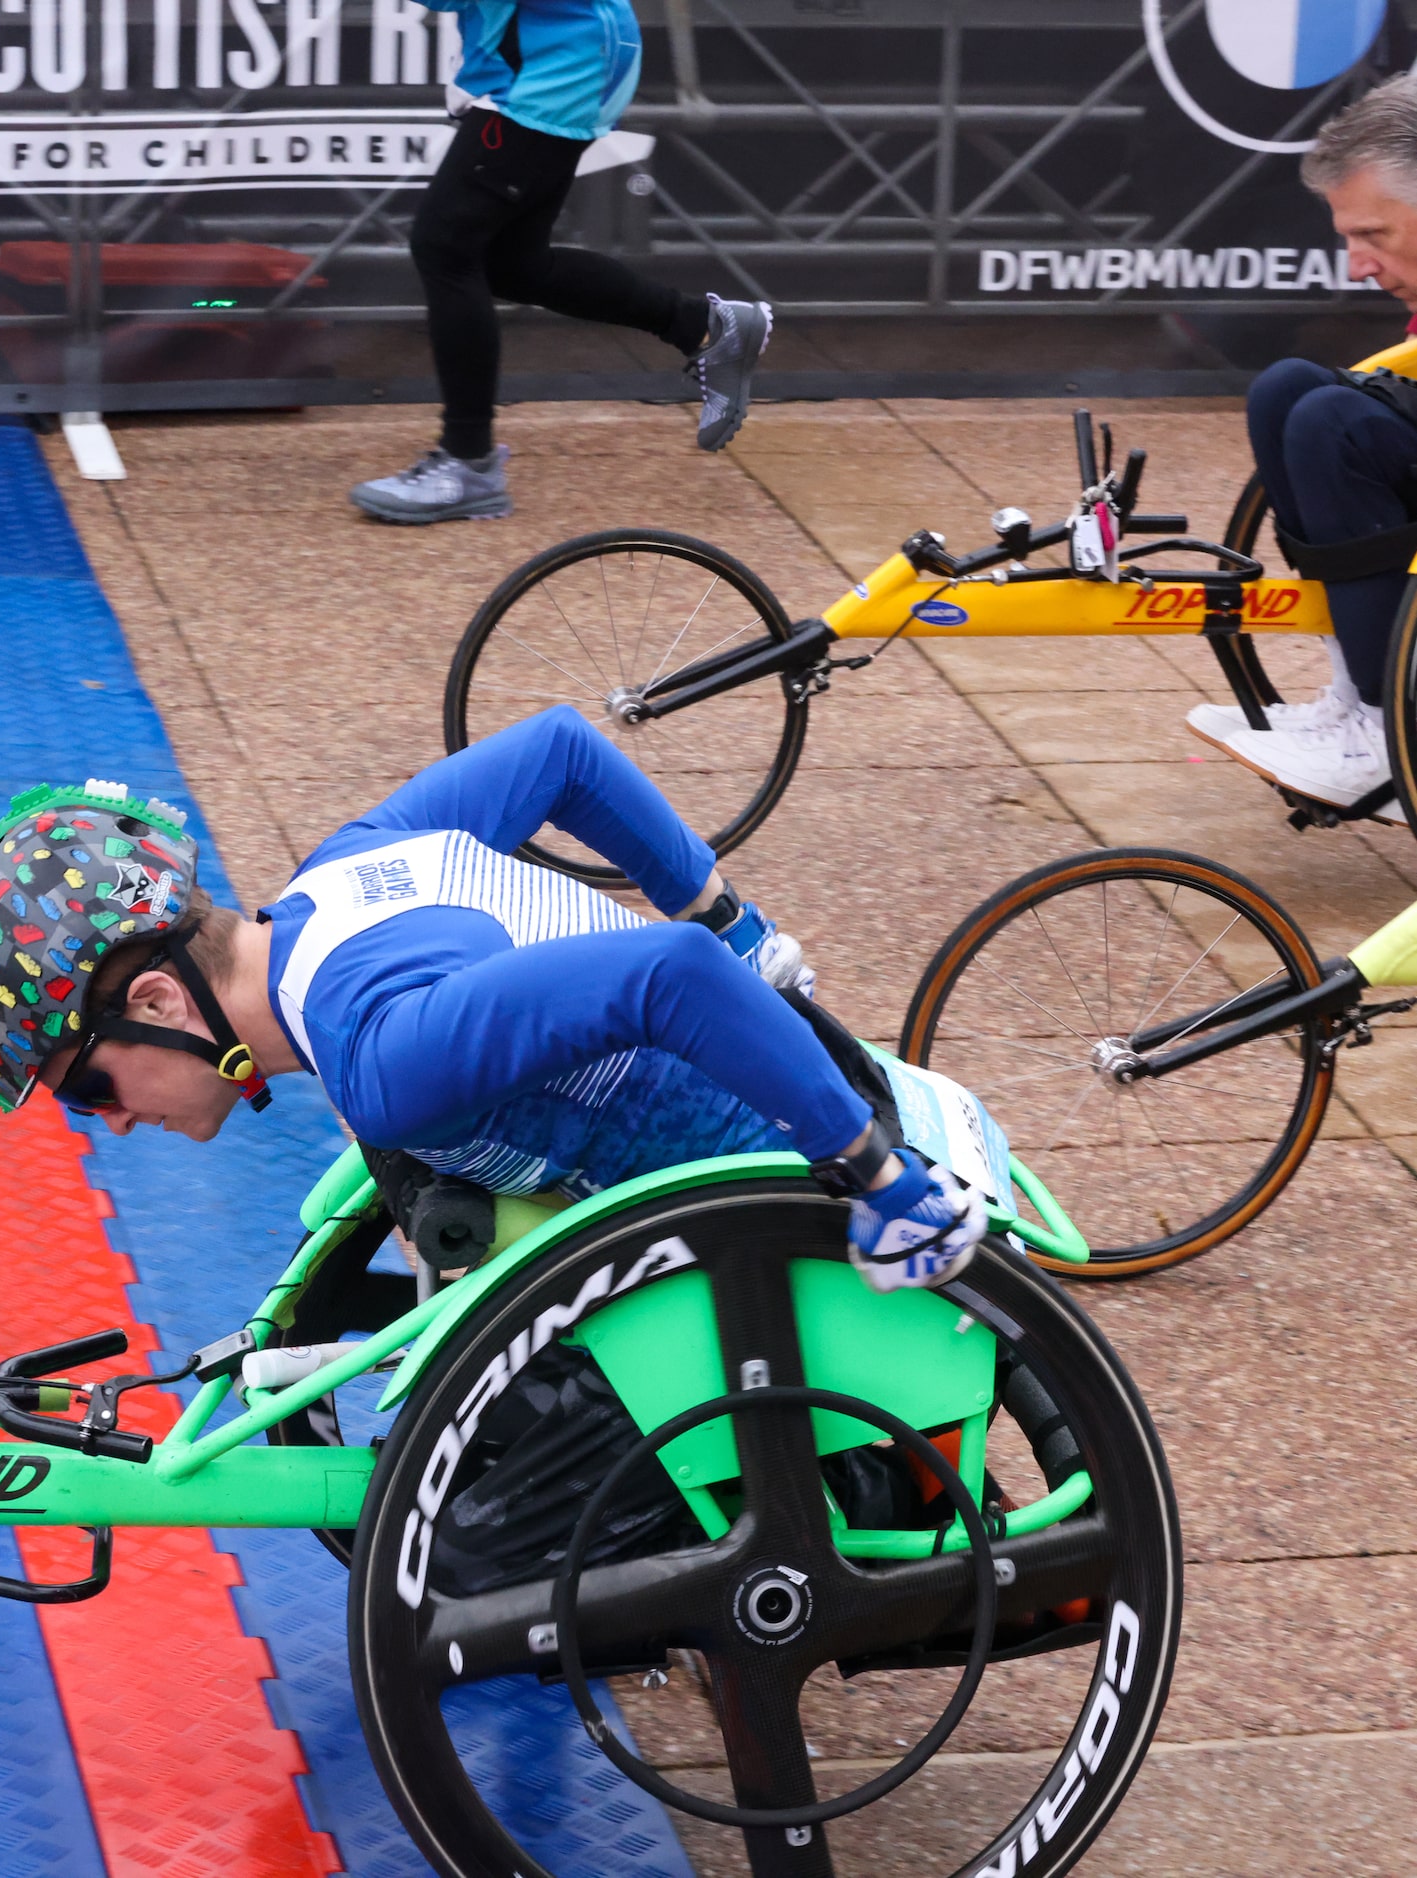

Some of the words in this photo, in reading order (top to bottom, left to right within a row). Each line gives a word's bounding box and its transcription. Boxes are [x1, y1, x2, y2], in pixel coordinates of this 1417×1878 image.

[12, 141, 110, 170] FOR
[142, 135, 431, 169] CHILDREN
[978, 247, 1384, 292] DFWBMWDEAL
[1124, 587, 1206, 619] TOP
[377, 858, 419, 901] GAMES
[396, 1235, 699, 1610] CORIMA
